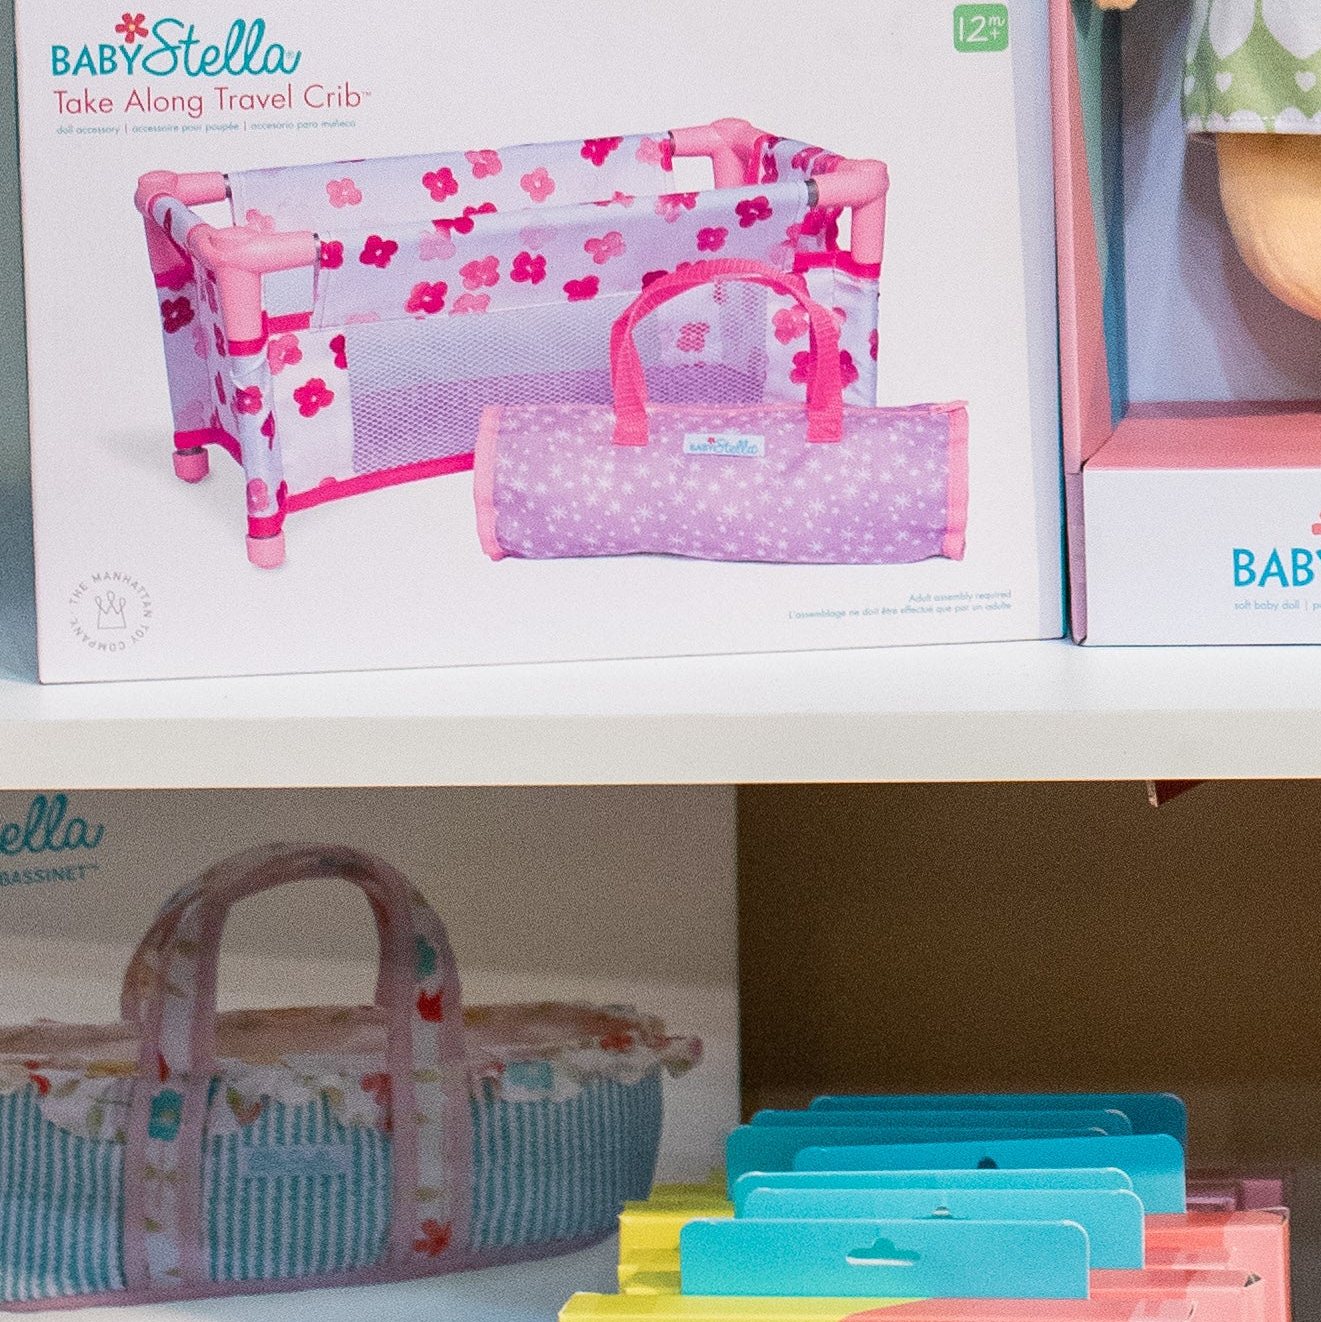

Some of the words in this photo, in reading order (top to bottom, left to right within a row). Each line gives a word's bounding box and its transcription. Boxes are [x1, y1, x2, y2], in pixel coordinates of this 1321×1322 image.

[54, 89, 114, 115] Take
[125, 88, 203, 119] Along
[214, 84, 292, 112] Travel
[69, 583, 88, 606] THE
[91, 572, 152, 618] MANHATTAN
